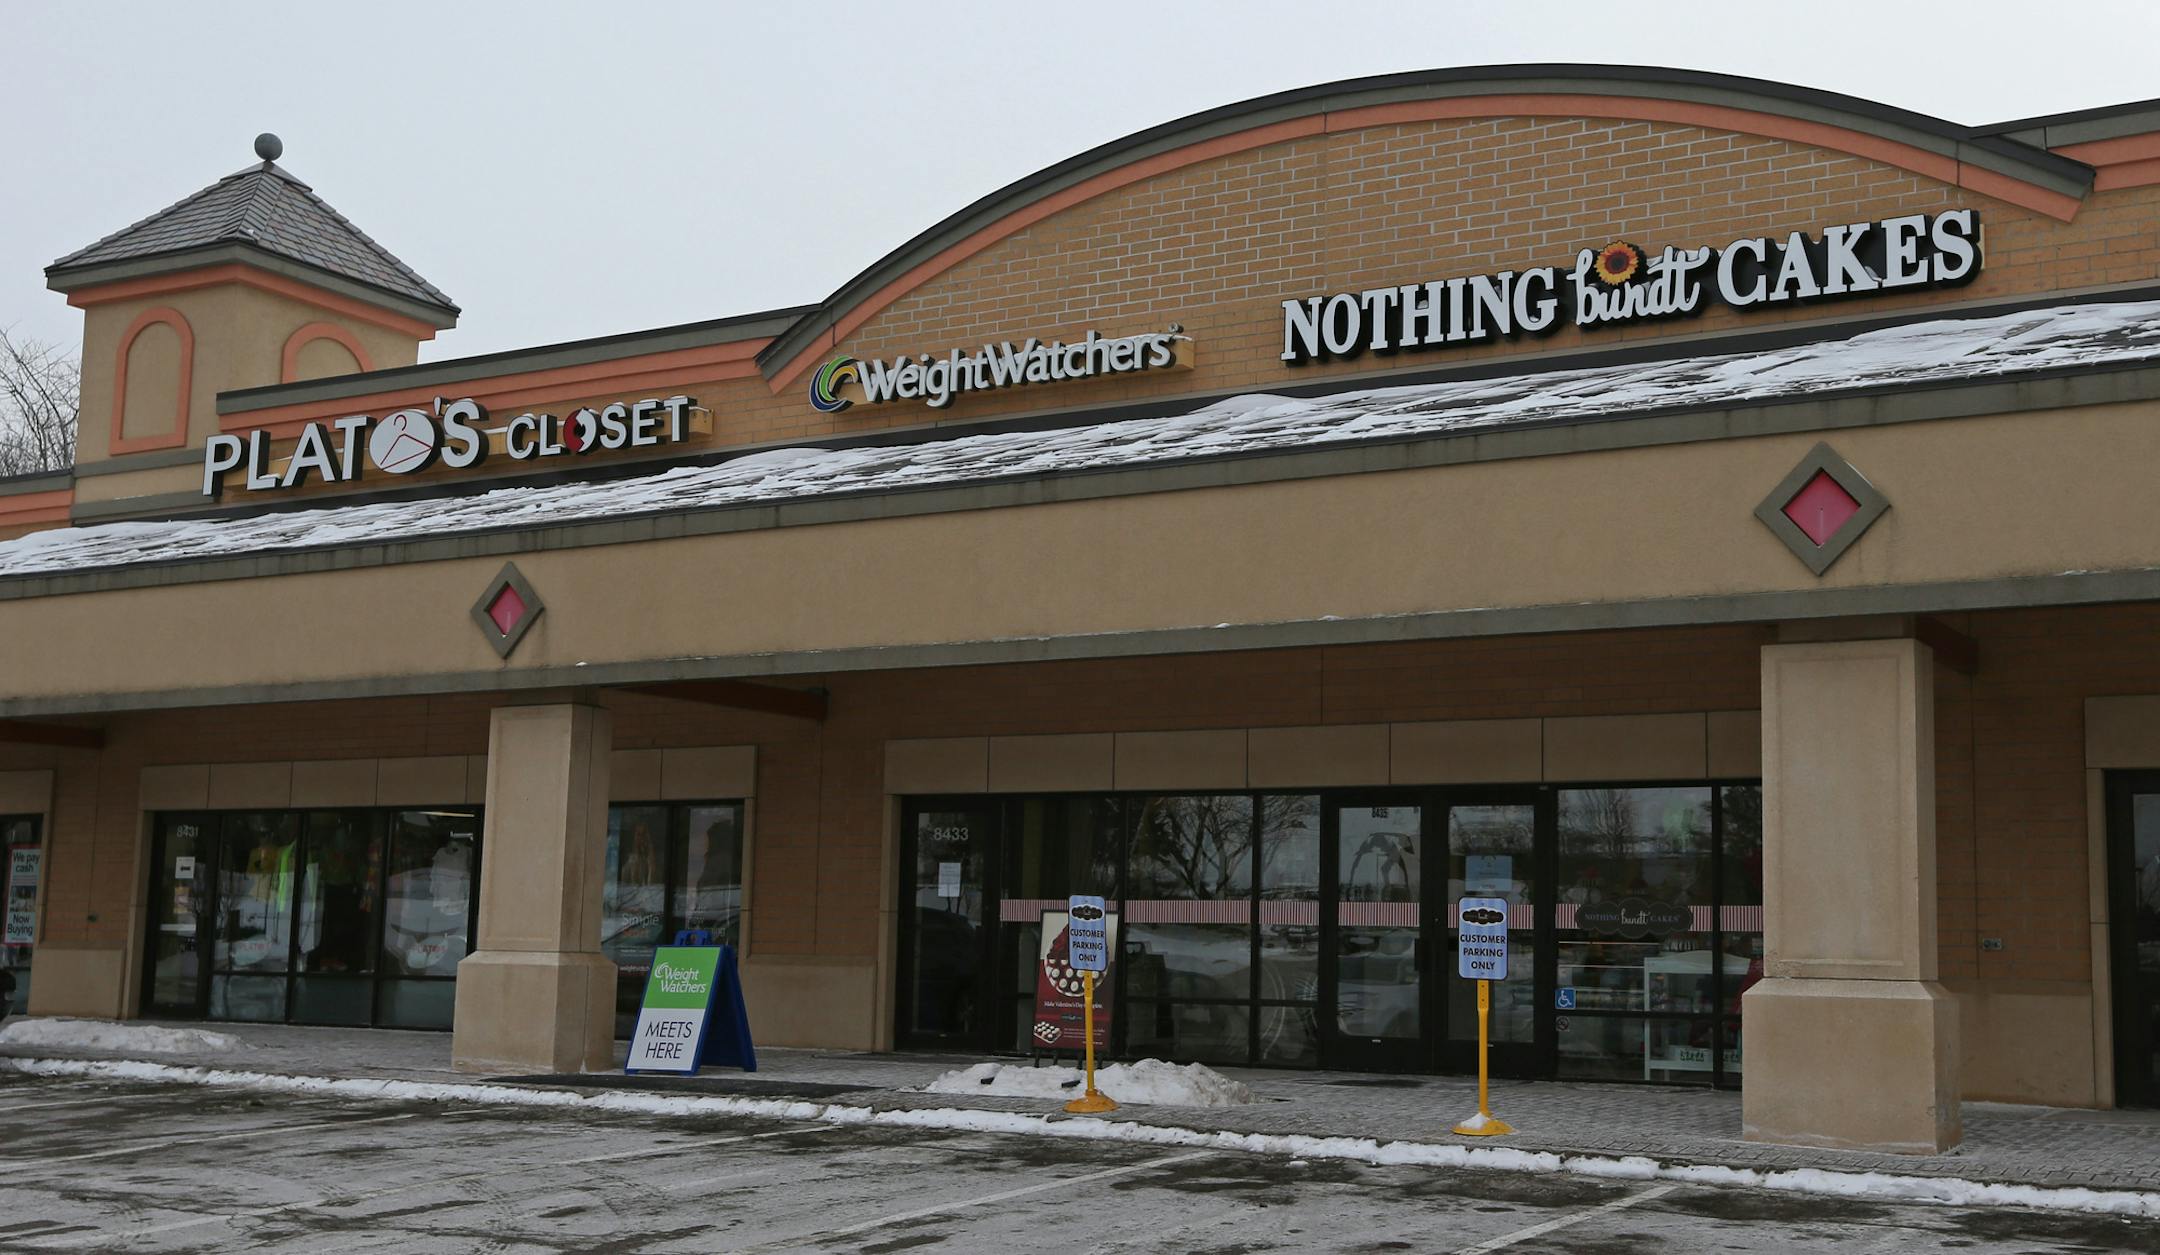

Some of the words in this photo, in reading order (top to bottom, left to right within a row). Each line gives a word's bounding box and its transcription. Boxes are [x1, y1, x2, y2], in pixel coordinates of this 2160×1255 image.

[1281, 267, 1558, 361] NOTHING
[1566, 247, 1711, 327] bundt
[1717, 208, 1979, 307] CAKES
[202, 396, 484, 496] PLATO'S
[506, 395, 691, 460] CLOSET
[933, 826, 969, 841] 8433
[13, 851, 25, 863] We
[26, 852, 41, 865] pay
[15, 863, 34, 873] cash
[13, 913, 30, 924] Now
[622, 912, 660, 929] Simple
[7, 923, 34, 936] Buying
[1069, 928, 1105, 938] CUSTOMER
[1072, 940, 1103, 951] PARKING
[1459, 933, 1506, 945] CUSTOMER
[1078, 953, 1097, 963] ONLY
[1463, 947, 1504, 958] PARKING
[1470, 960, 1496, 970] ONLY
[664, 967, 700, 983] Weight
[661, 979, 707, 994] Watchers
[645, 1021, 693, 1039] MEETS
[645, 1042, 684, 1059] HERE
